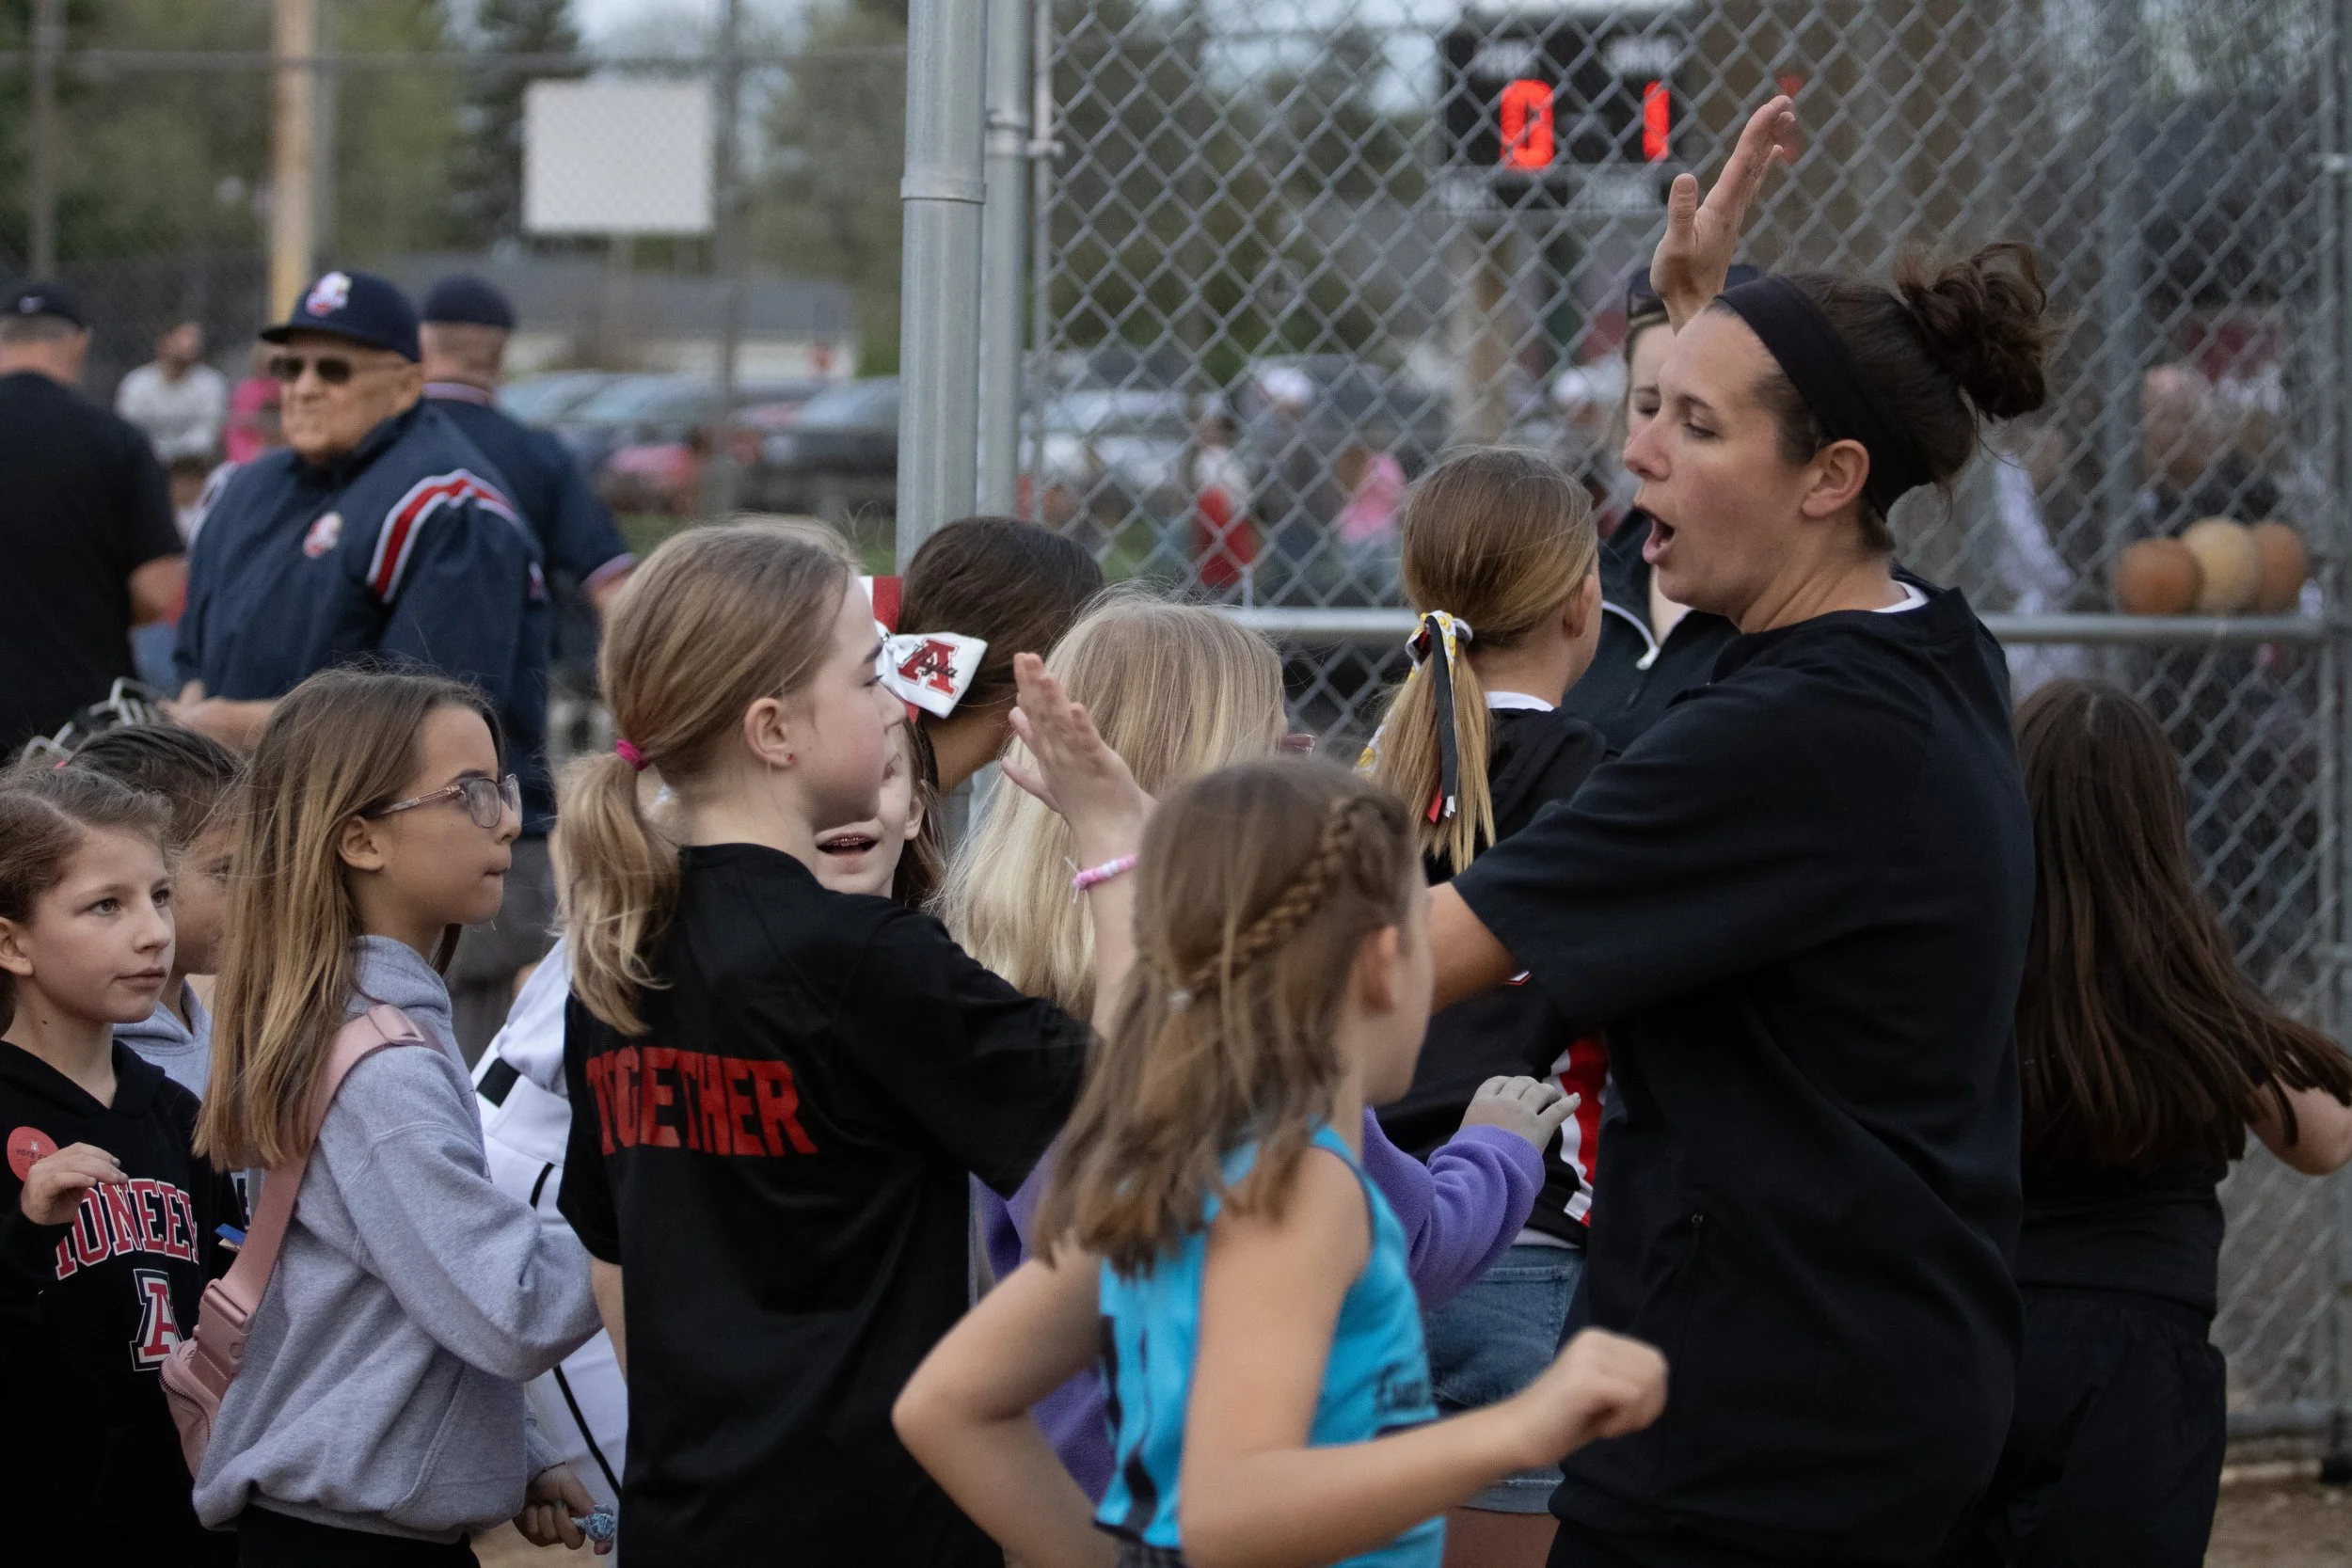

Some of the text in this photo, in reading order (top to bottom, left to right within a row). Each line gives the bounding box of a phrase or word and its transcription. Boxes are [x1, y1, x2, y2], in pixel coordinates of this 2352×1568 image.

[1500, 79, 1554, 170] 0
[1643, 80, 1671, 162] 1
[897, 638, 960, 699] A
[585, 1045, 818, 1157] TOGETHER
[16, 1148, 36, 1159] VOTE
[56, 1178, 199, 1281] IONEE
